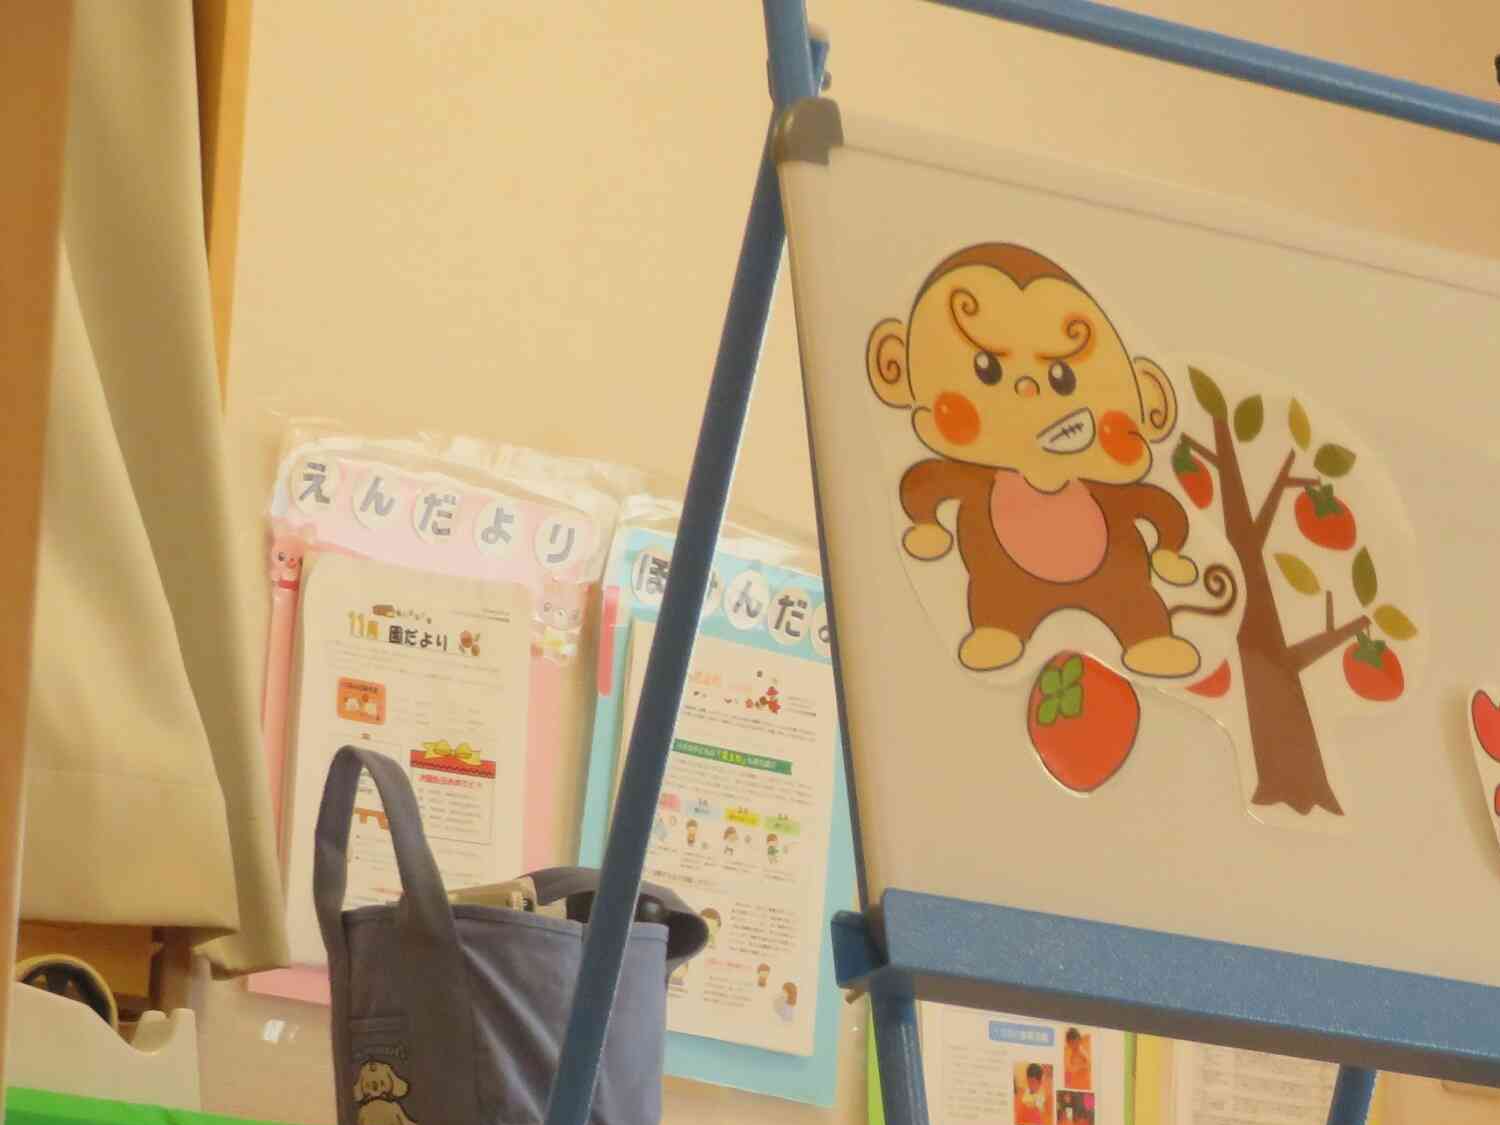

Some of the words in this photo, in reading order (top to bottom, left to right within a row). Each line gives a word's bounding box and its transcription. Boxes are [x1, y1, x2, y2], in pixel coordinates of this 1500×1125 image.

[299, 461, 576, 564] えんだより
